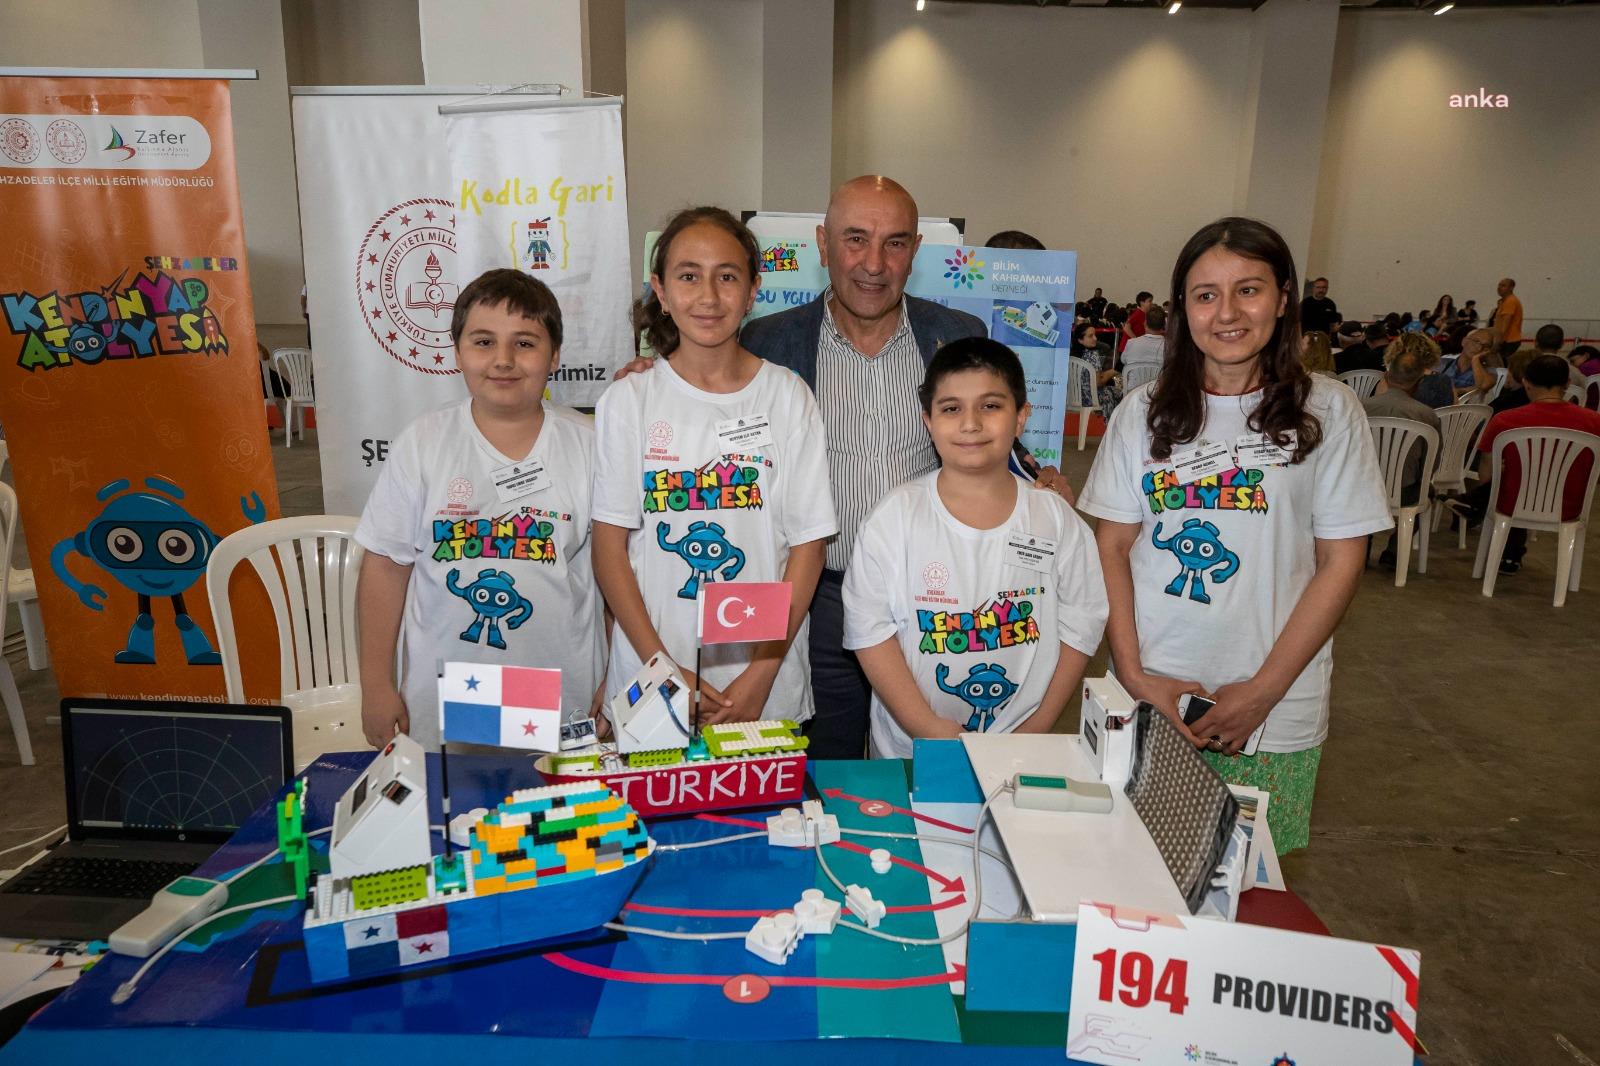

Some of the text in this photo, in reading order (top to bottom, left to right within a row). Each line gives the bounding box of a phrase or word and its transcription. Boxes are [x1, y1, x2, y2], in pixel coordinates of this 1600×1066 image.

[134, 129, 186, 144] Zafer
[58, 174, 80, 186] İLÇE
[83, 174, 110, 187] MİLLİ
[113, 175, 149, 187] EĞİTİM
[151, 176, 214, 187] MÜDÜRLÜĞÜ
[460, 175, 615, 217] Kodla Gari
[385, 231, 425, 300] CUMHURİYETİ
[992, 260, 1020, 271] BİLİM
[992, 273, 1070, 285] KAHRAMANLARI
[755, 289, 777, 304] SU
[389, 303, 427, 341] TÜRKİYE
[361, 438, 393, 468] ŞE
[721, 453, 773, 469] ŞEHZADEER
[997, 586, 1046, 601] ŞEHZADELR
[606, 761, 798, 807] TÜRKİYE
[1092, 947, 1396, 1035] 194 PROVIDERS
